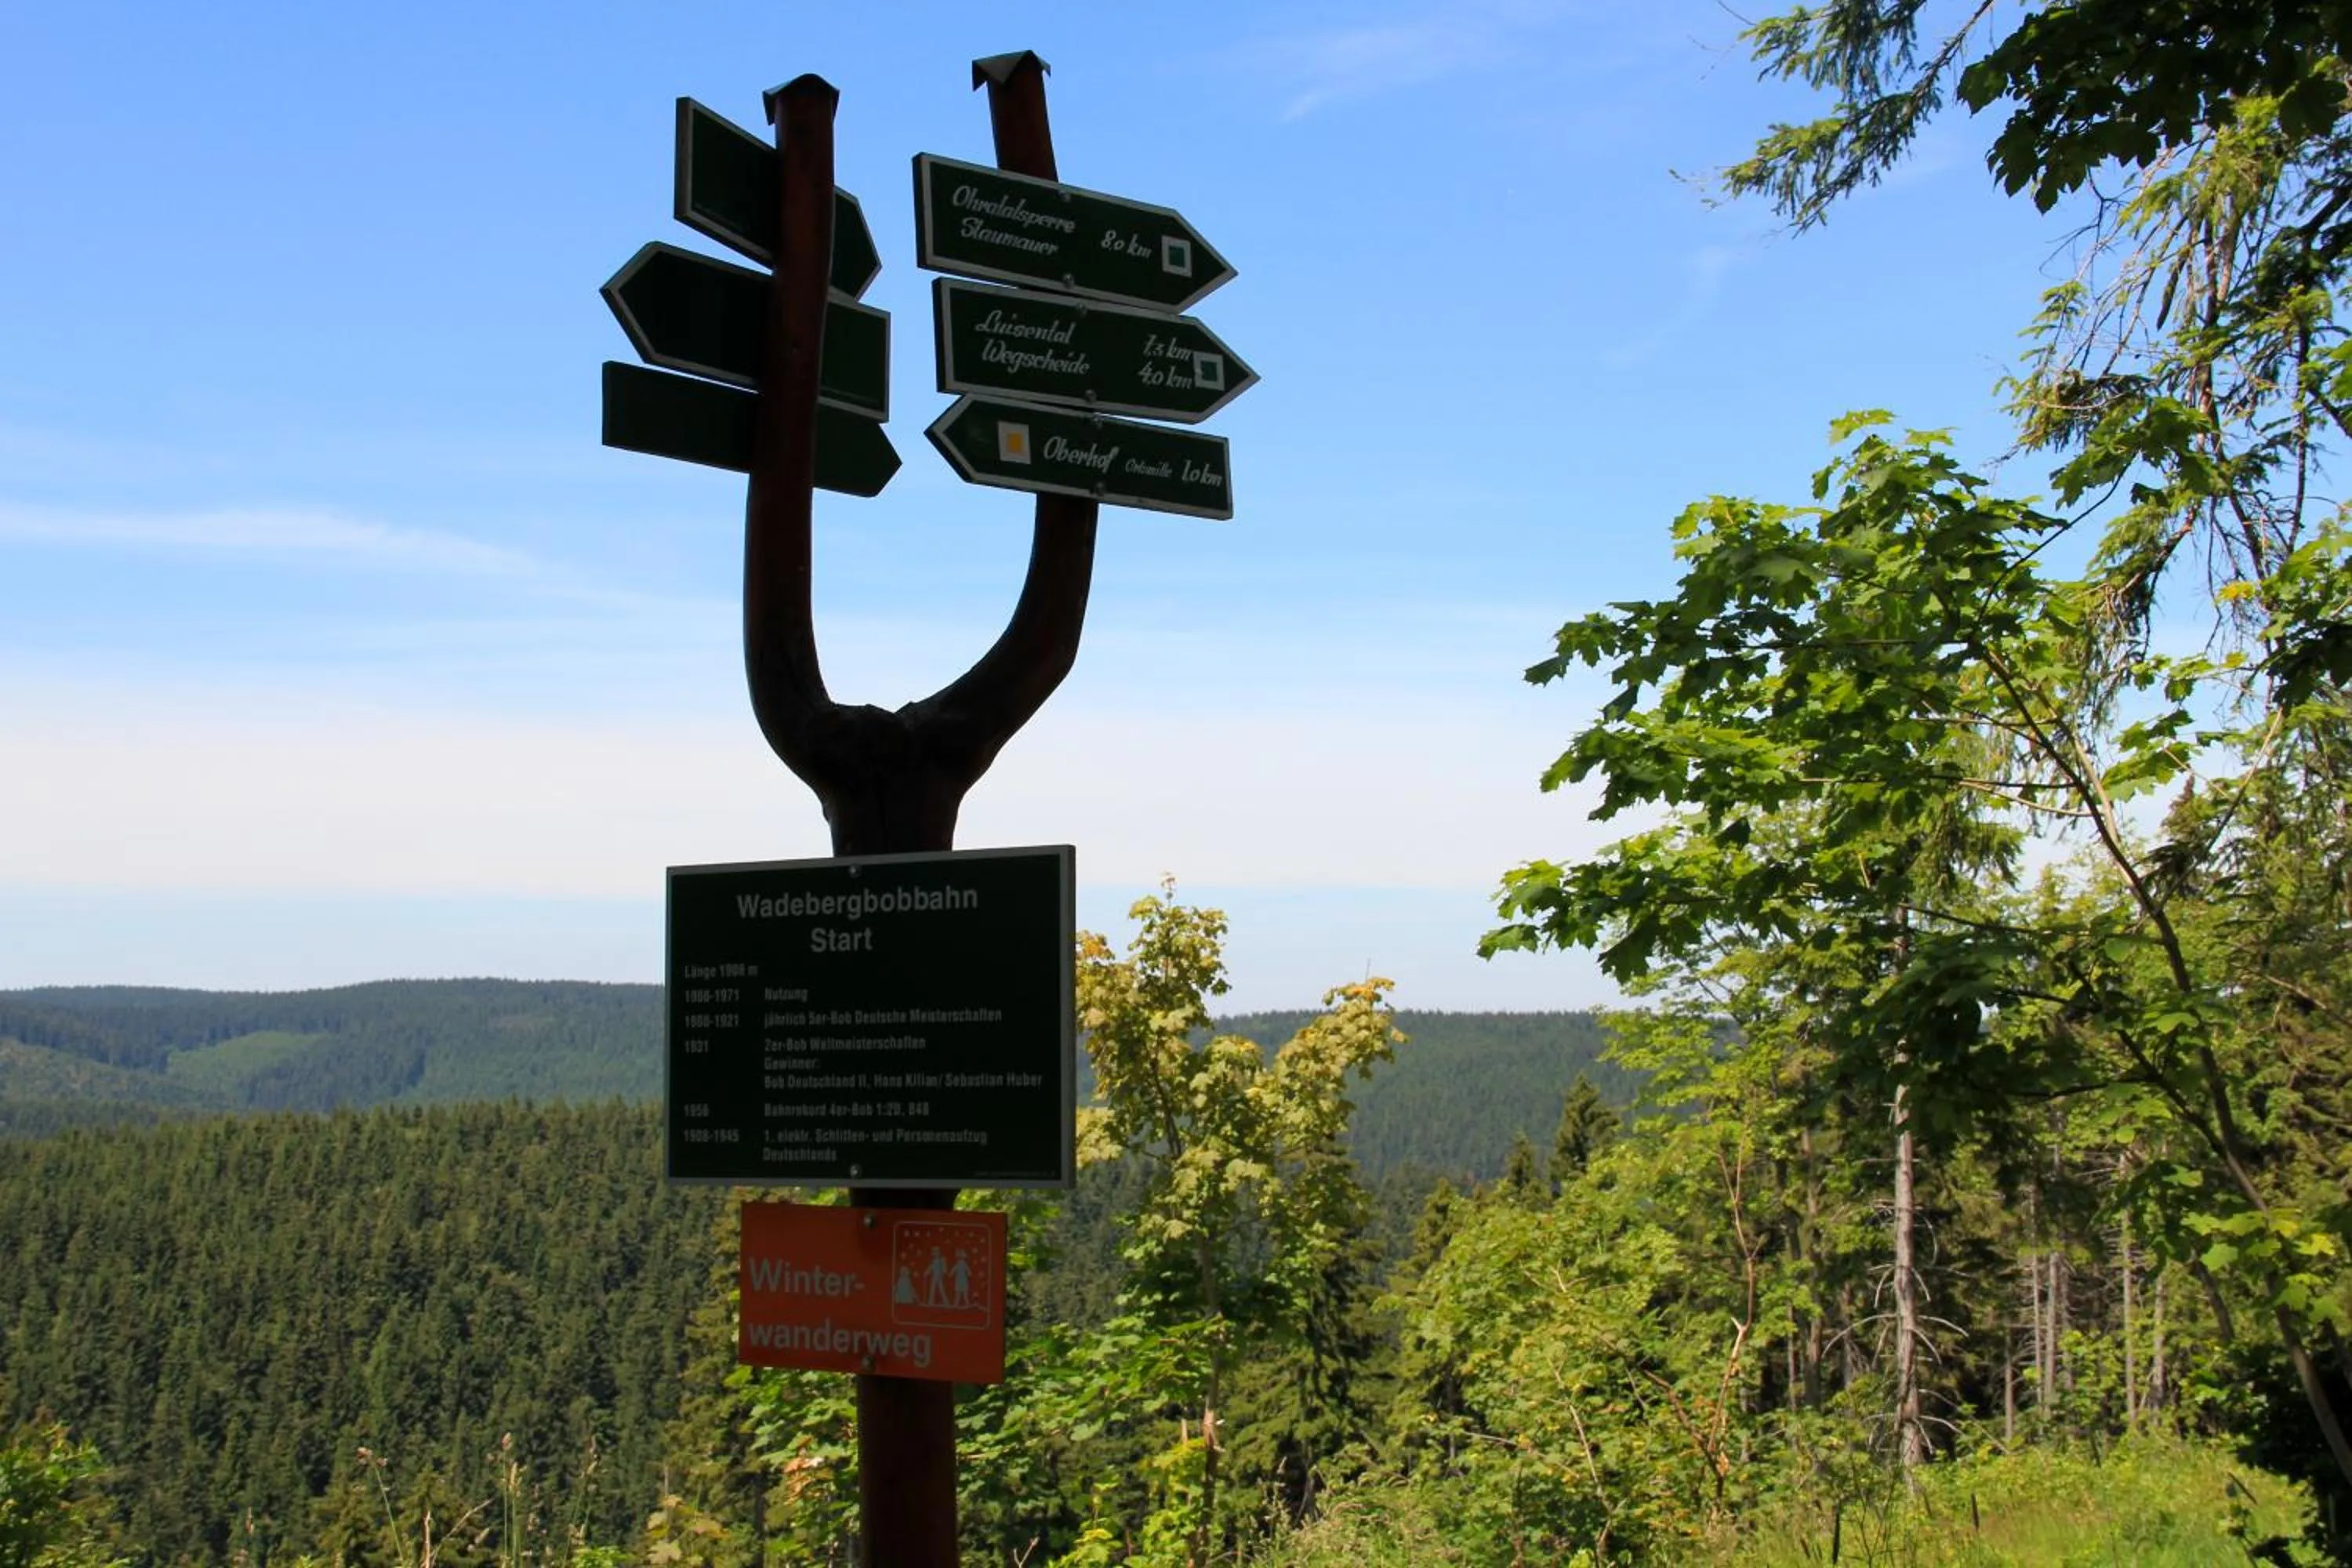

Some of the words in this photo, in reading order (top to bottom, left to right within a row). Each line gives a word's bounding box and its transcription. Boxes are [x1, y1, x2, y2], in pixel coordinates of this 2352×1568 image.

[952, 185, 1076, 234] Ohratalsperre
[960, 218, 1059, 256] Staumauer
[1127, 233, 1152, 259] km
[975, 310, 1076, 344] Luisental
[982, 338, 1091, 375] Wegscheide
[1166, 336, 1193, 361] km
[1166, 365, 1192, 390] km
[1044, 436, 1120, 473] Oberhof
[736, 887, 978, 920] Wadebergbobbahn
[810, 927, 873, 953] Start
[764, 987, 808, 1003] Nutzung
[855, 1009, 906, 1025] Deutsche
[909, 1007, 1003, 1023] Meisterschaften
[809, 1035, 927, 1051] Weltmeisterschaften
[764, 1074, 785, 1089] Bob
[787, 1073, 855, 1089] Deutschland
[1006, 1072, 1043, 1087] Huber
[873, 1129, 893, 1142] und
[763, 1147, 837, 1162] Deutschlands
[748, 1256, 866, 1298] Winter-
[747, 1317, 931, 1367] wanderweg
